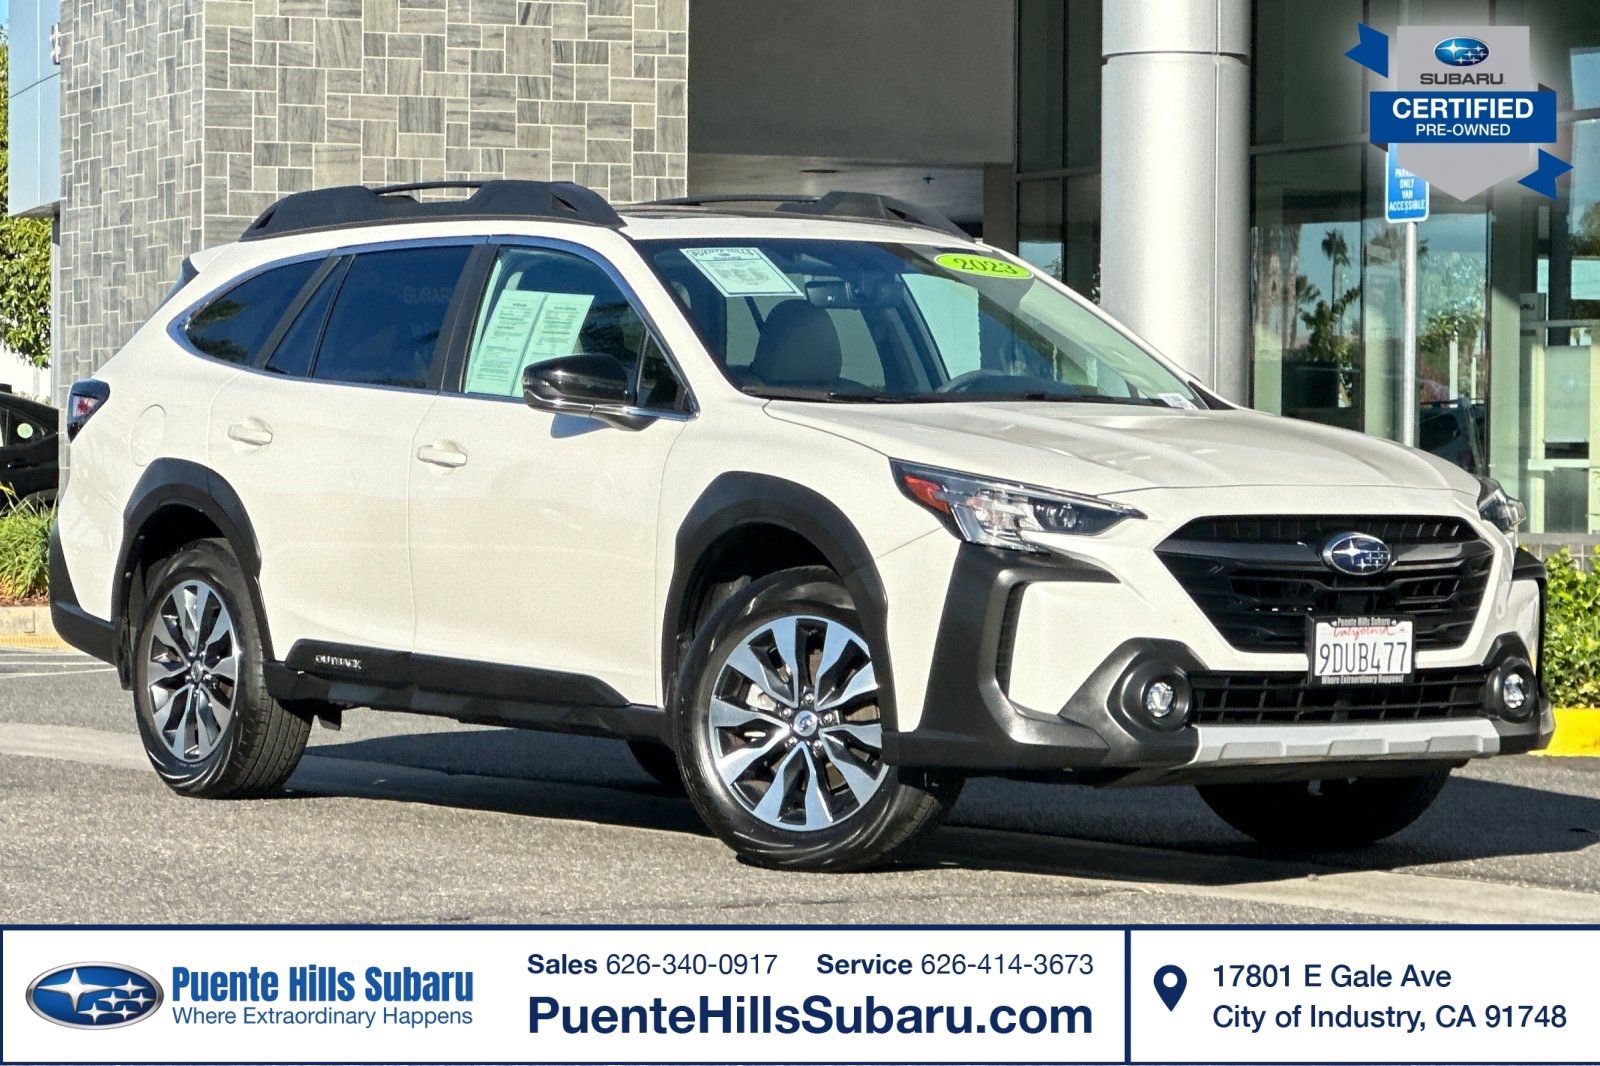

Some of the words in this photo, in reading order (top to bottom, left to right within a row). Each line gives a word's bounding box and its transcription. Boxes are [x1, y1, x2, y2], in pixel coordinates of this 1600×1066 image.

[1400, 178, 1415, 189] ONLY
[1402, 189, 1414, 199] VAN
[1389, 199, 1425, 211] ACCESSIBLE
[953, 258, 1018, 275] 2023
[315, 654, 362, 669] OUTBACK
[1319, 641, 1407, 674] 9DUB477
